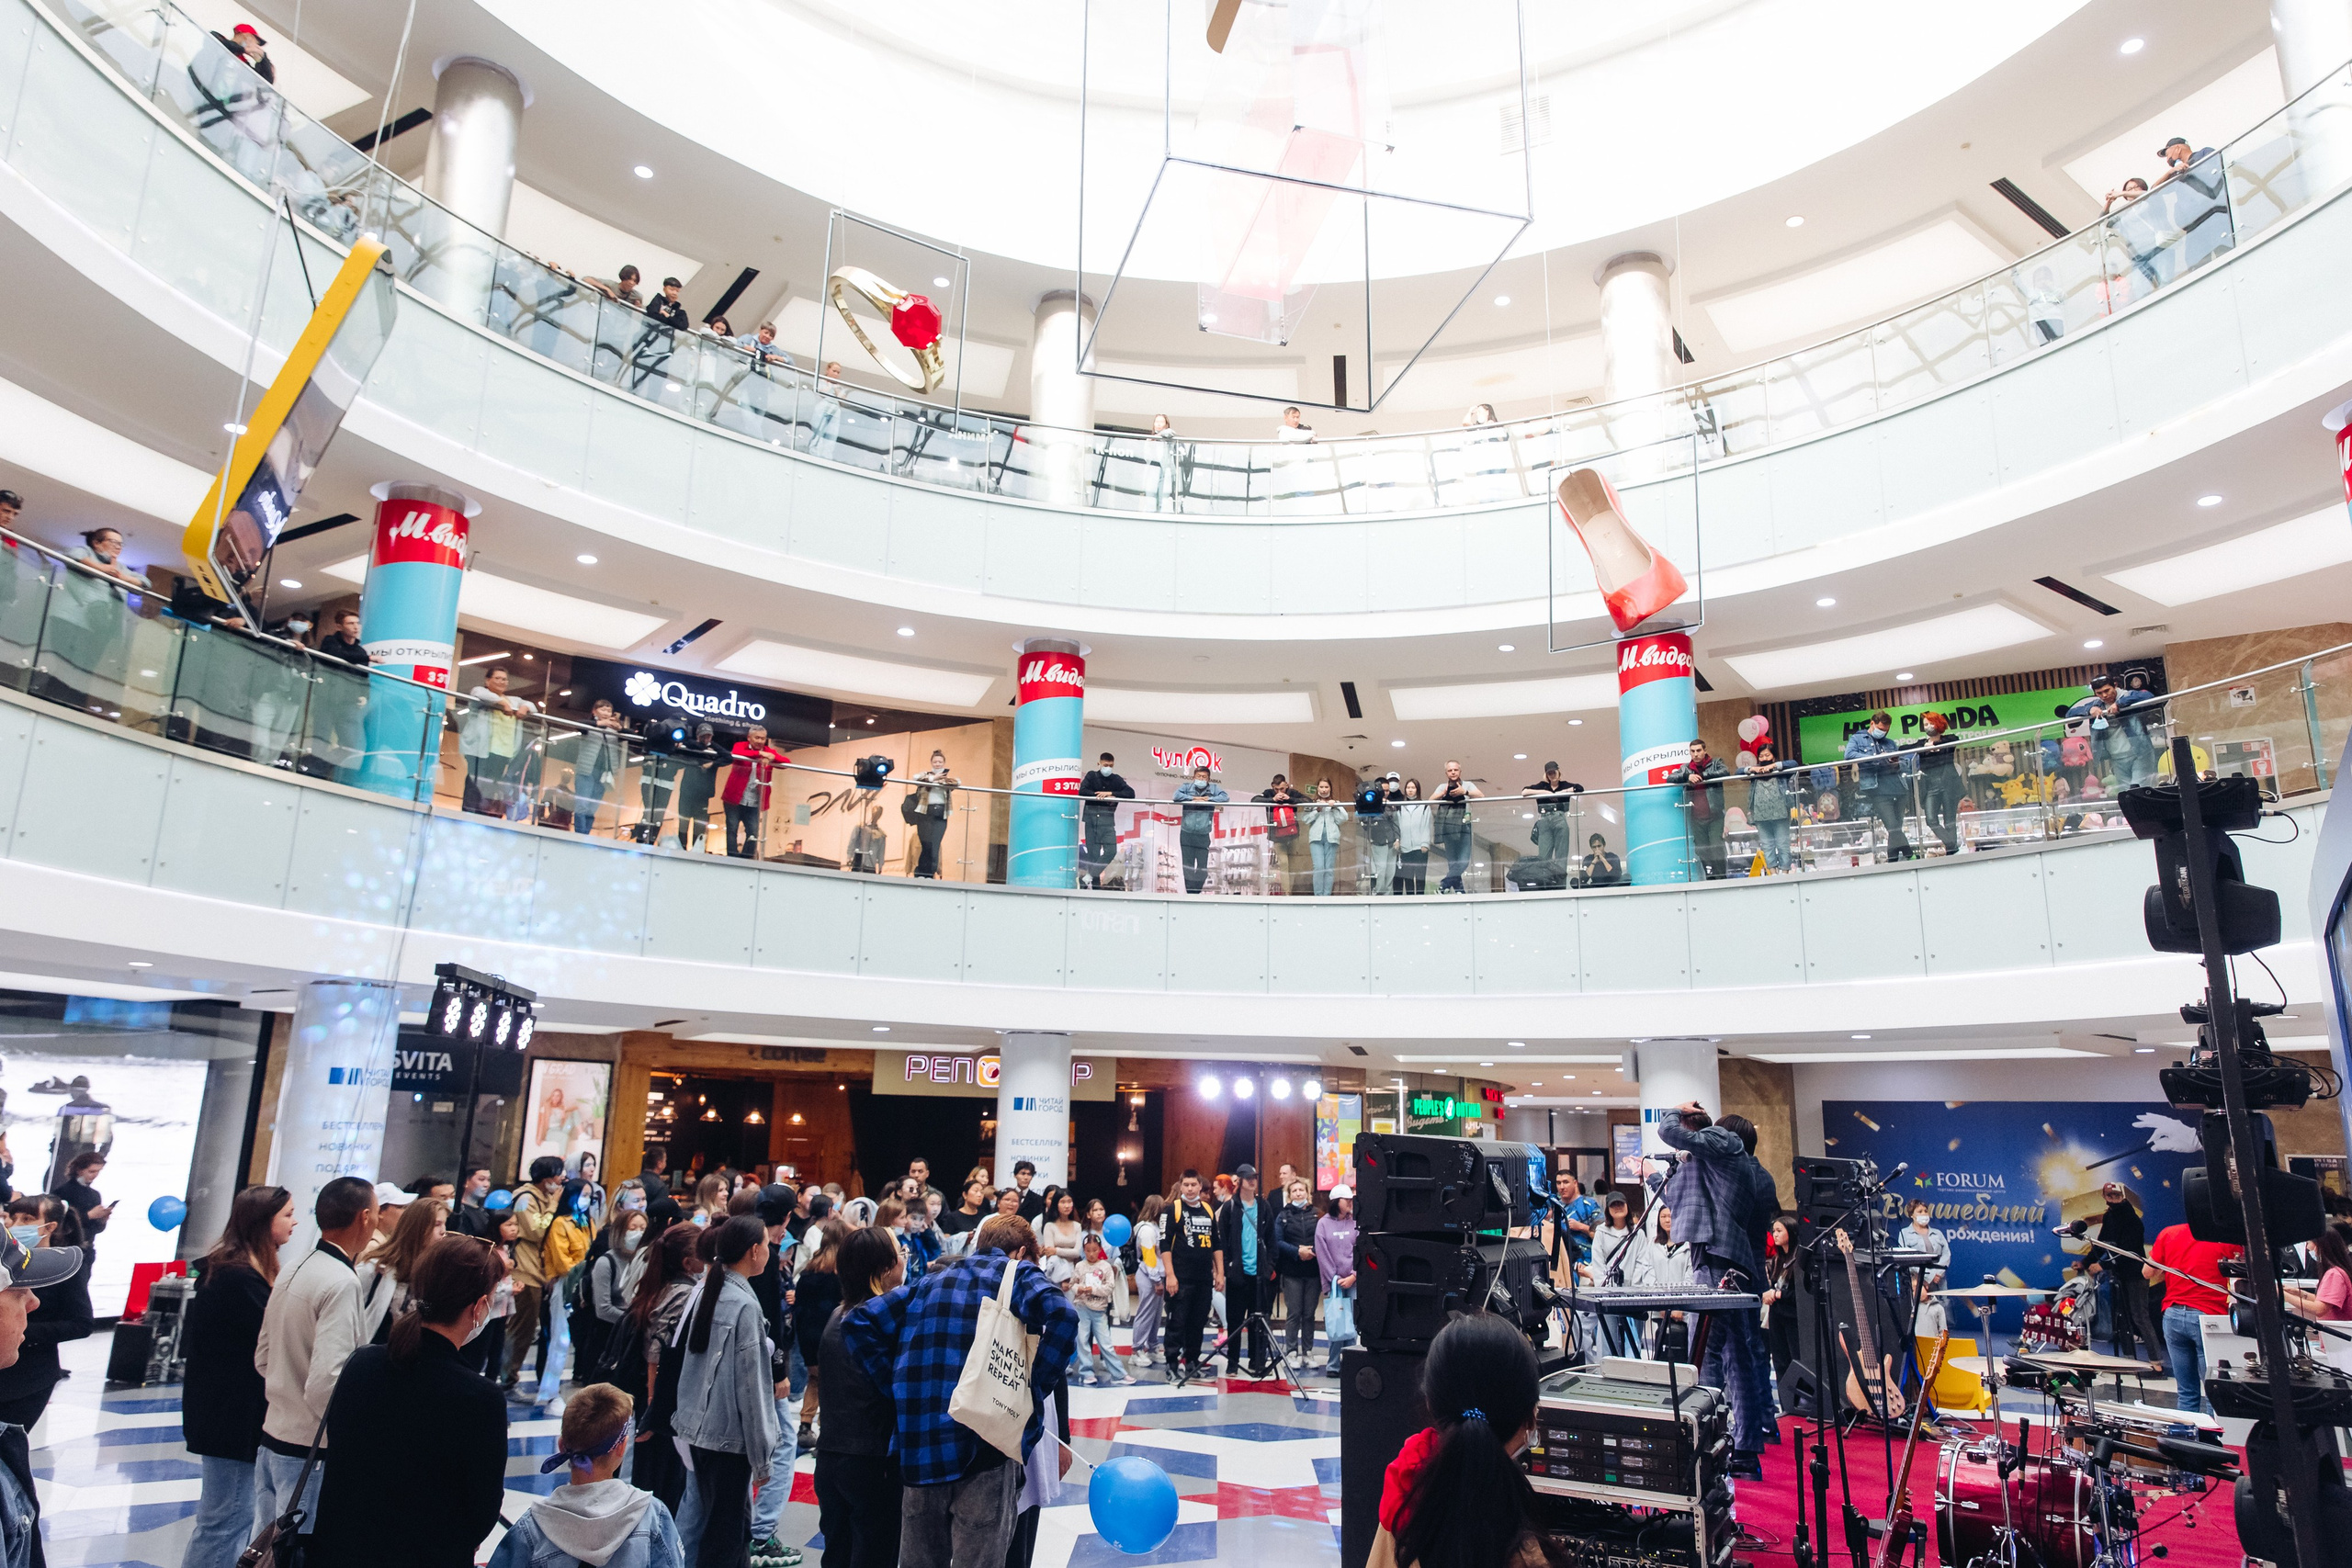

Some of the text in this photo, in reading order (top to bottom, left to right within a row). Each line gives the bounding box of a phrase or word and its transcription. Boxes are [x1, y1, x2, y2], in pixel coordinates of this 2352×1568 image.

[1619, 644, 1692, 674] М.видео
[662, 682, 766, 720] Quadro
[1634, 749, 1690, 767] ОТКРЫЛИС
[395, 1071, 441, 1080] EVENTS
[1936, 1172, 2006, 1189] FORUM
[1198, 1234, 1212, 1248] 75
[1946, 1229, 2034, 1244] рождения!
[990, 1349, 1012, 1372] SKIN
[992, 1338, 1024, 1368] MAKEU
[988, 1362, 1021, 1392] REPEAT
[992, 1397, 1021, 1419] TONYMOLY
